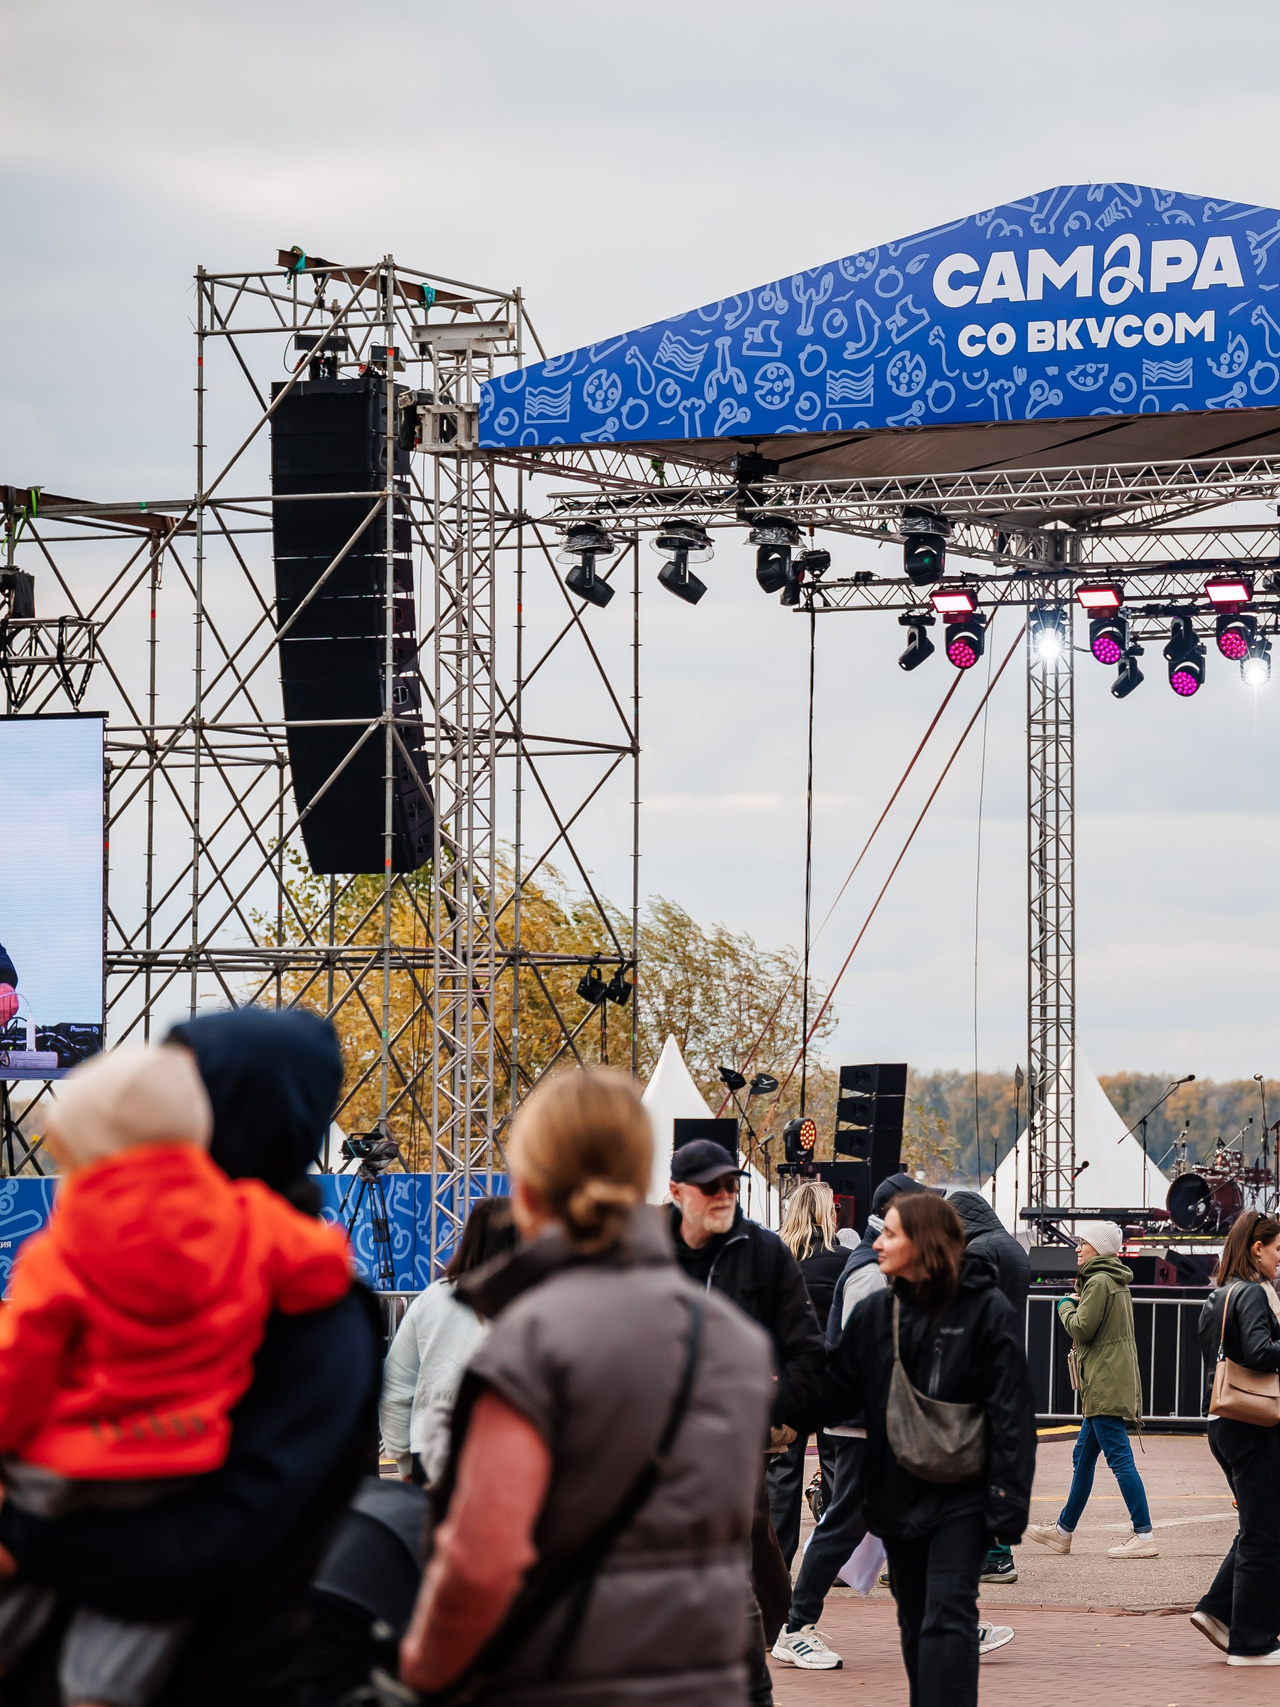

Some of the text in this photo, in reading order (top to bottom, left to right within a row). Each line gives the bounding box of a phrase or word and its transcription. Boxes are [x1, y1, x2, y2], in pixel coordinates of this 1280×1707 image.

[933, 233, 1245, 308] САМАРА
[957, 310, 1216, 358] СО ВКУСОМ
